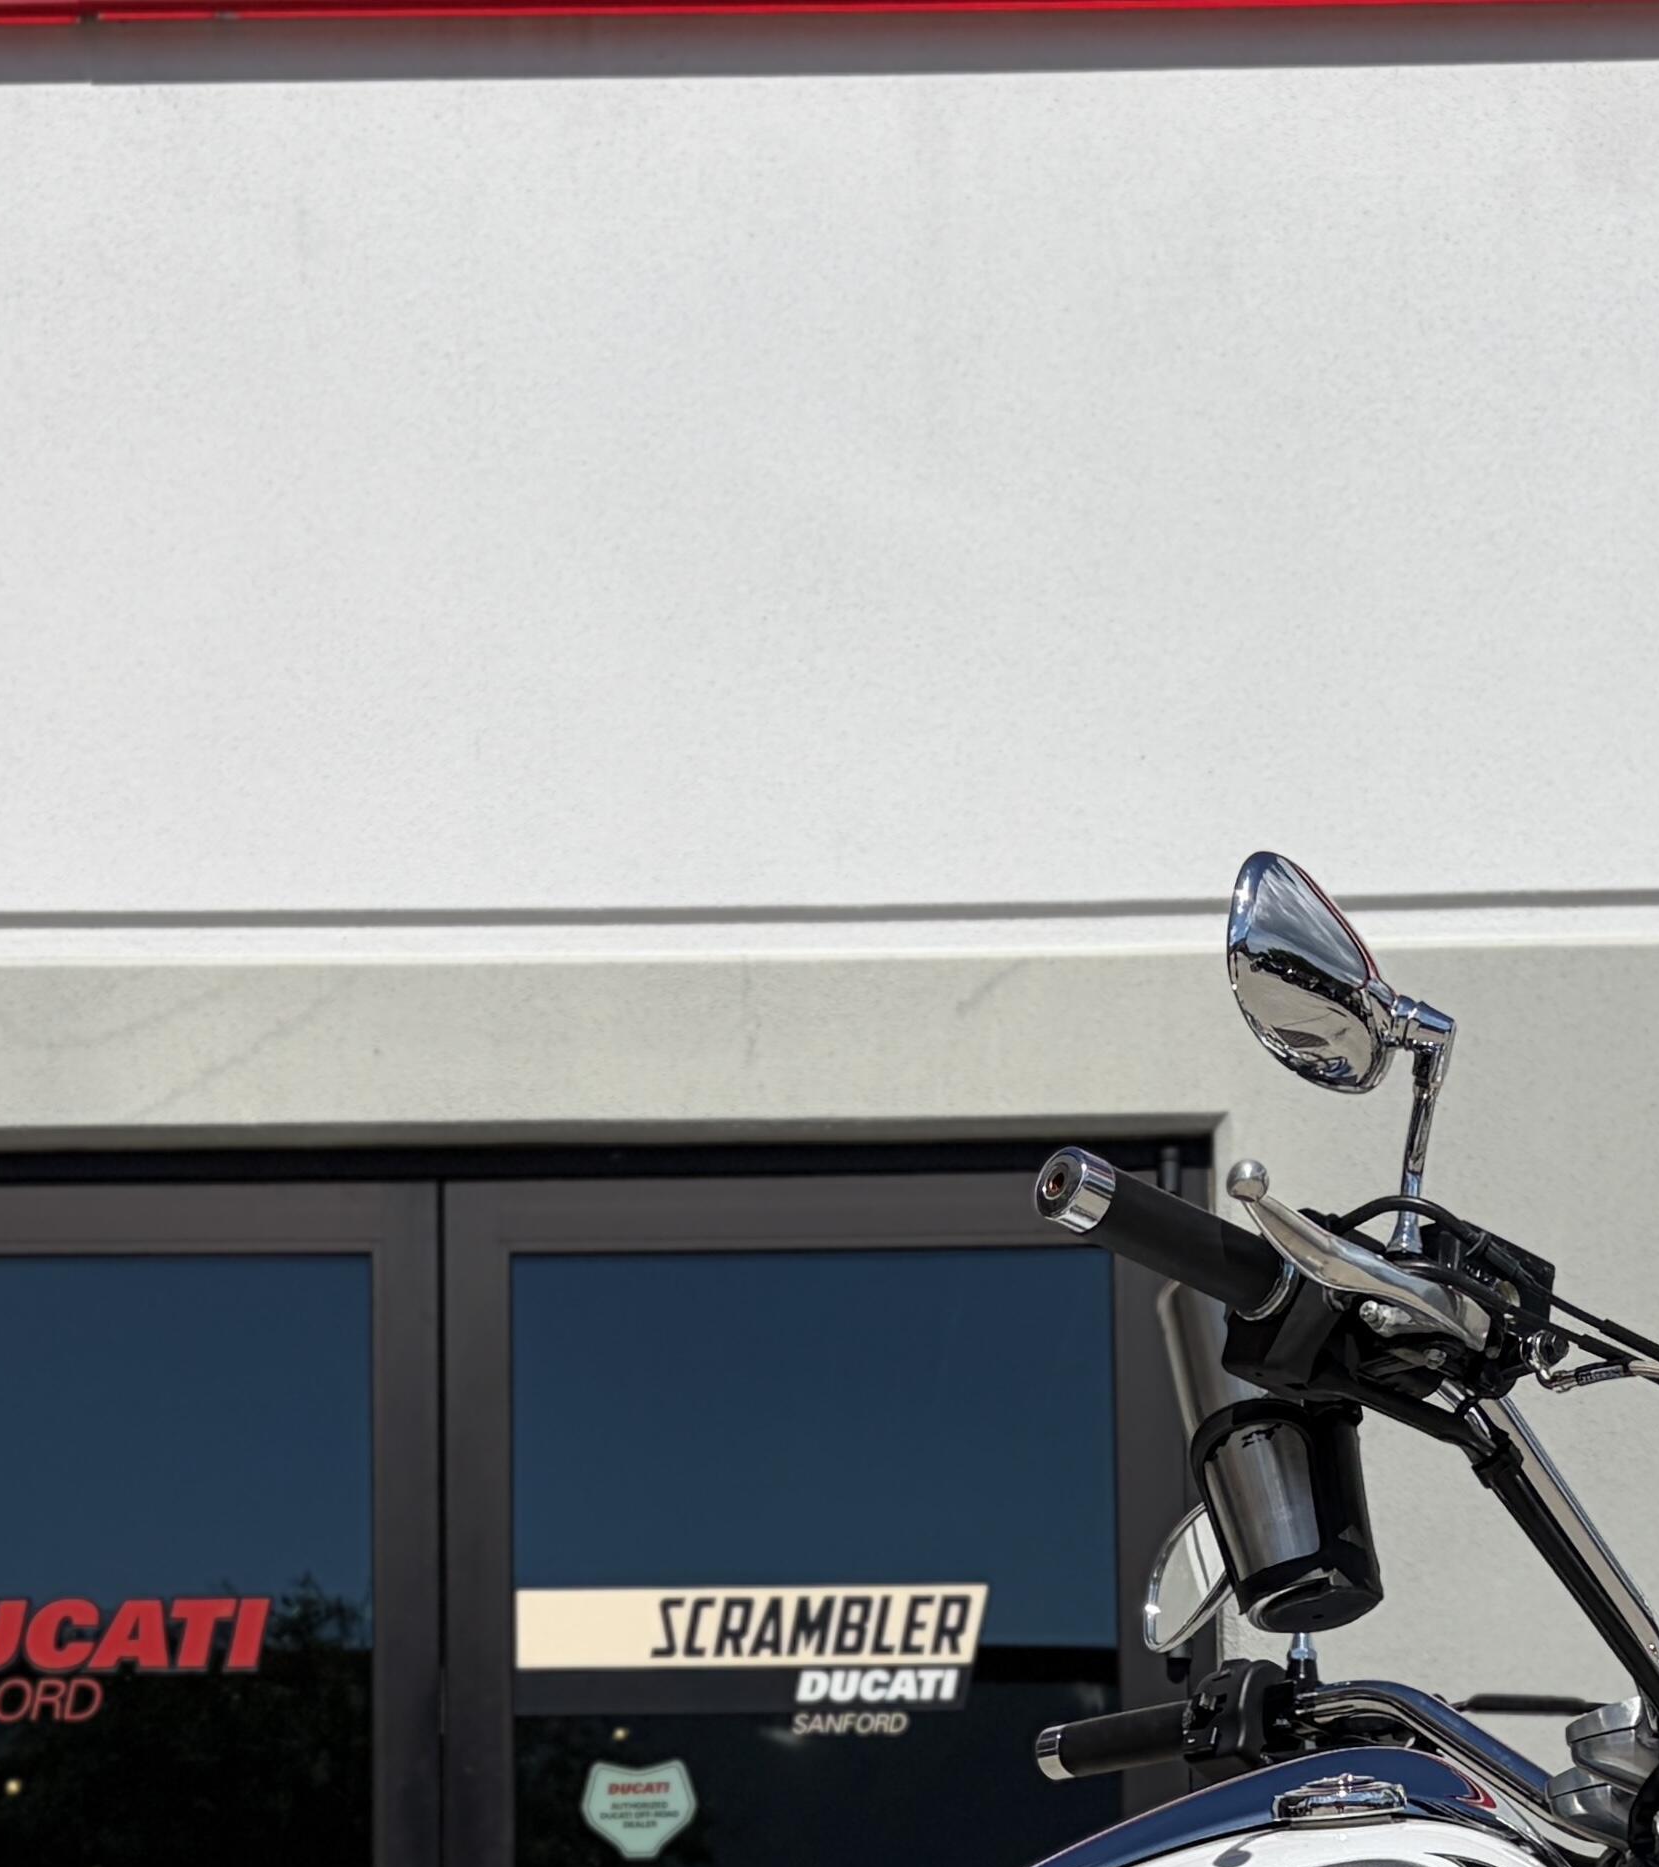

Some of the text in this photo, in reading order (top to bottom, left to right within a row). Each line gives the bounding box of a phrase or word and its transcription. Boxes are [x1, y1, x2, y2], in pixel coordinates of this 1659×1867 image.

[650, 1594, 971, 1658] SCRAMBLER
[795, 1668, 959, 1702] DUCATI
[792, 1711, 908, 1735] SANFORD
[607, 1781, 671, 1795] DUCATI
